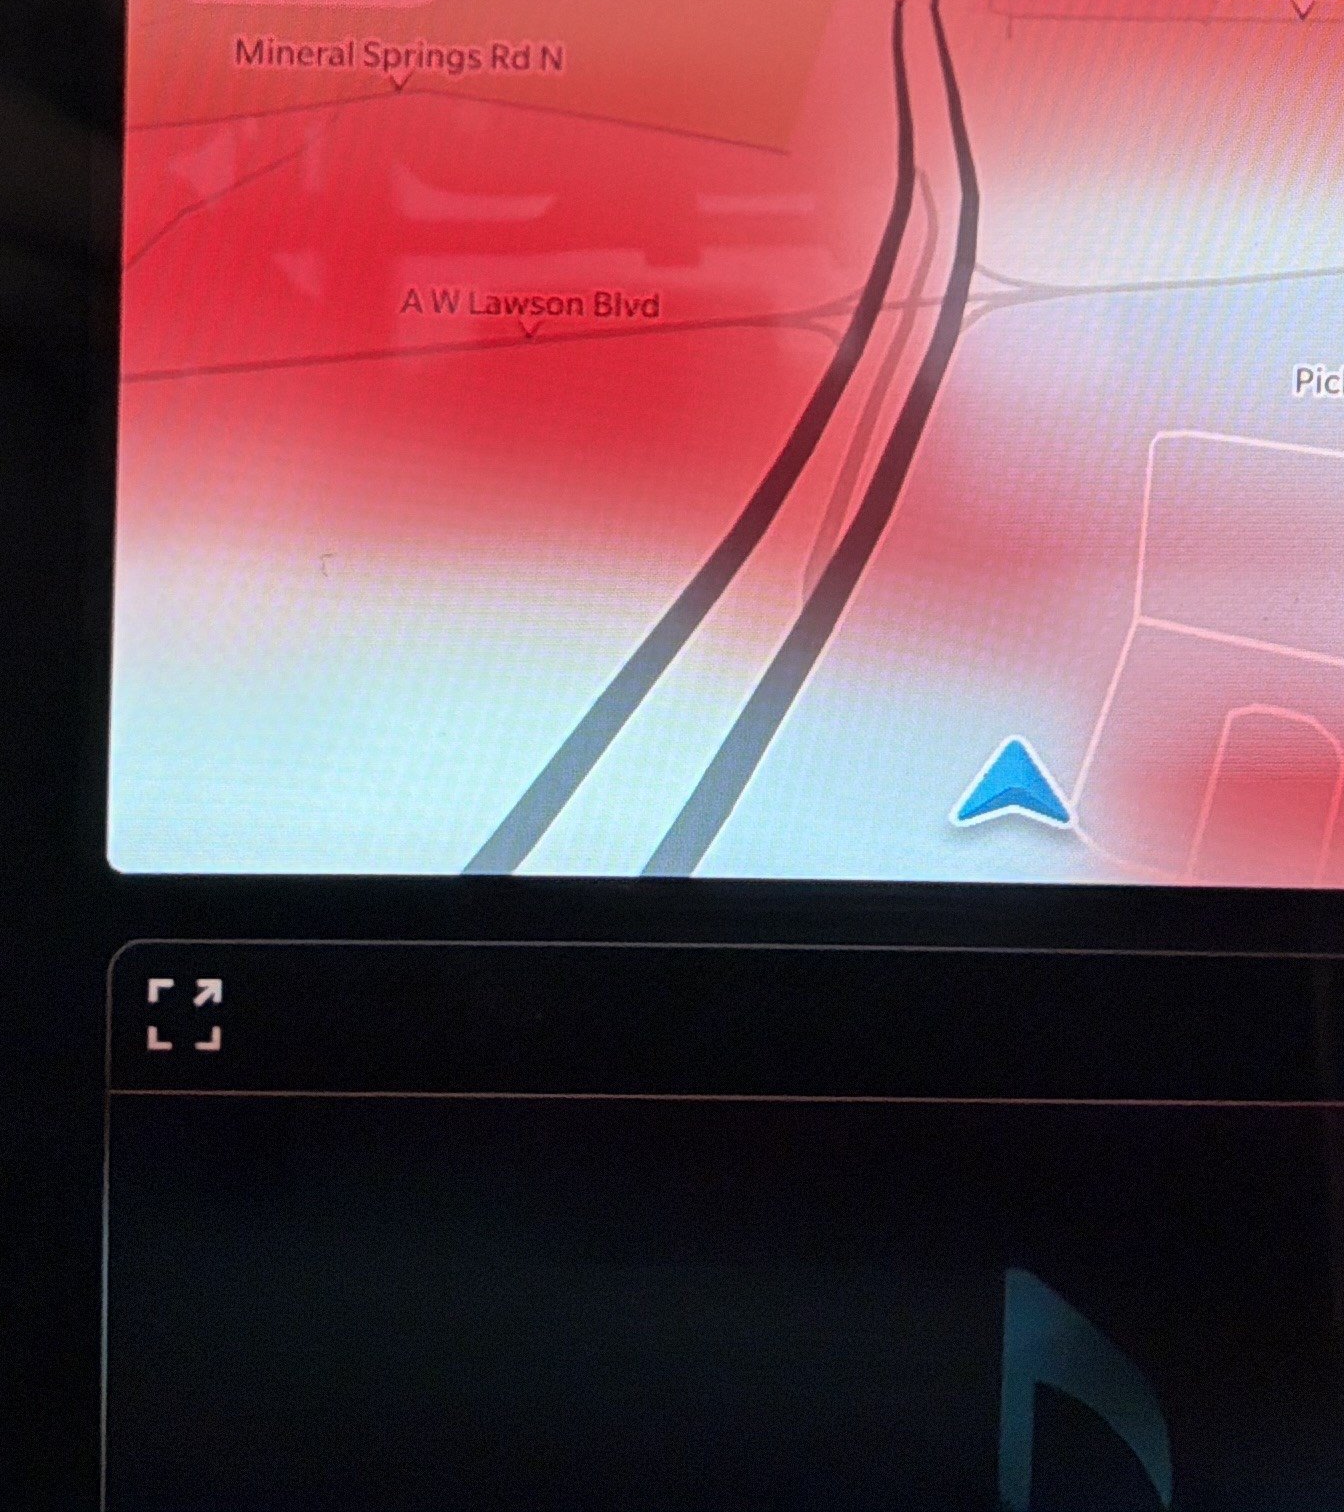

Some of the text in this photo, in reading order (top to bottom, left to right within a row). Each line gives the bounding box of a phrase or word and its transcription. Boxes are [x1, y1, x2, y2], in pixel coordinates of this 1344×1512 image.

[235, 38, 564, 74] Mineral Springs Rd N
[400, 290, 661, 319] A W Lawson Blvd
